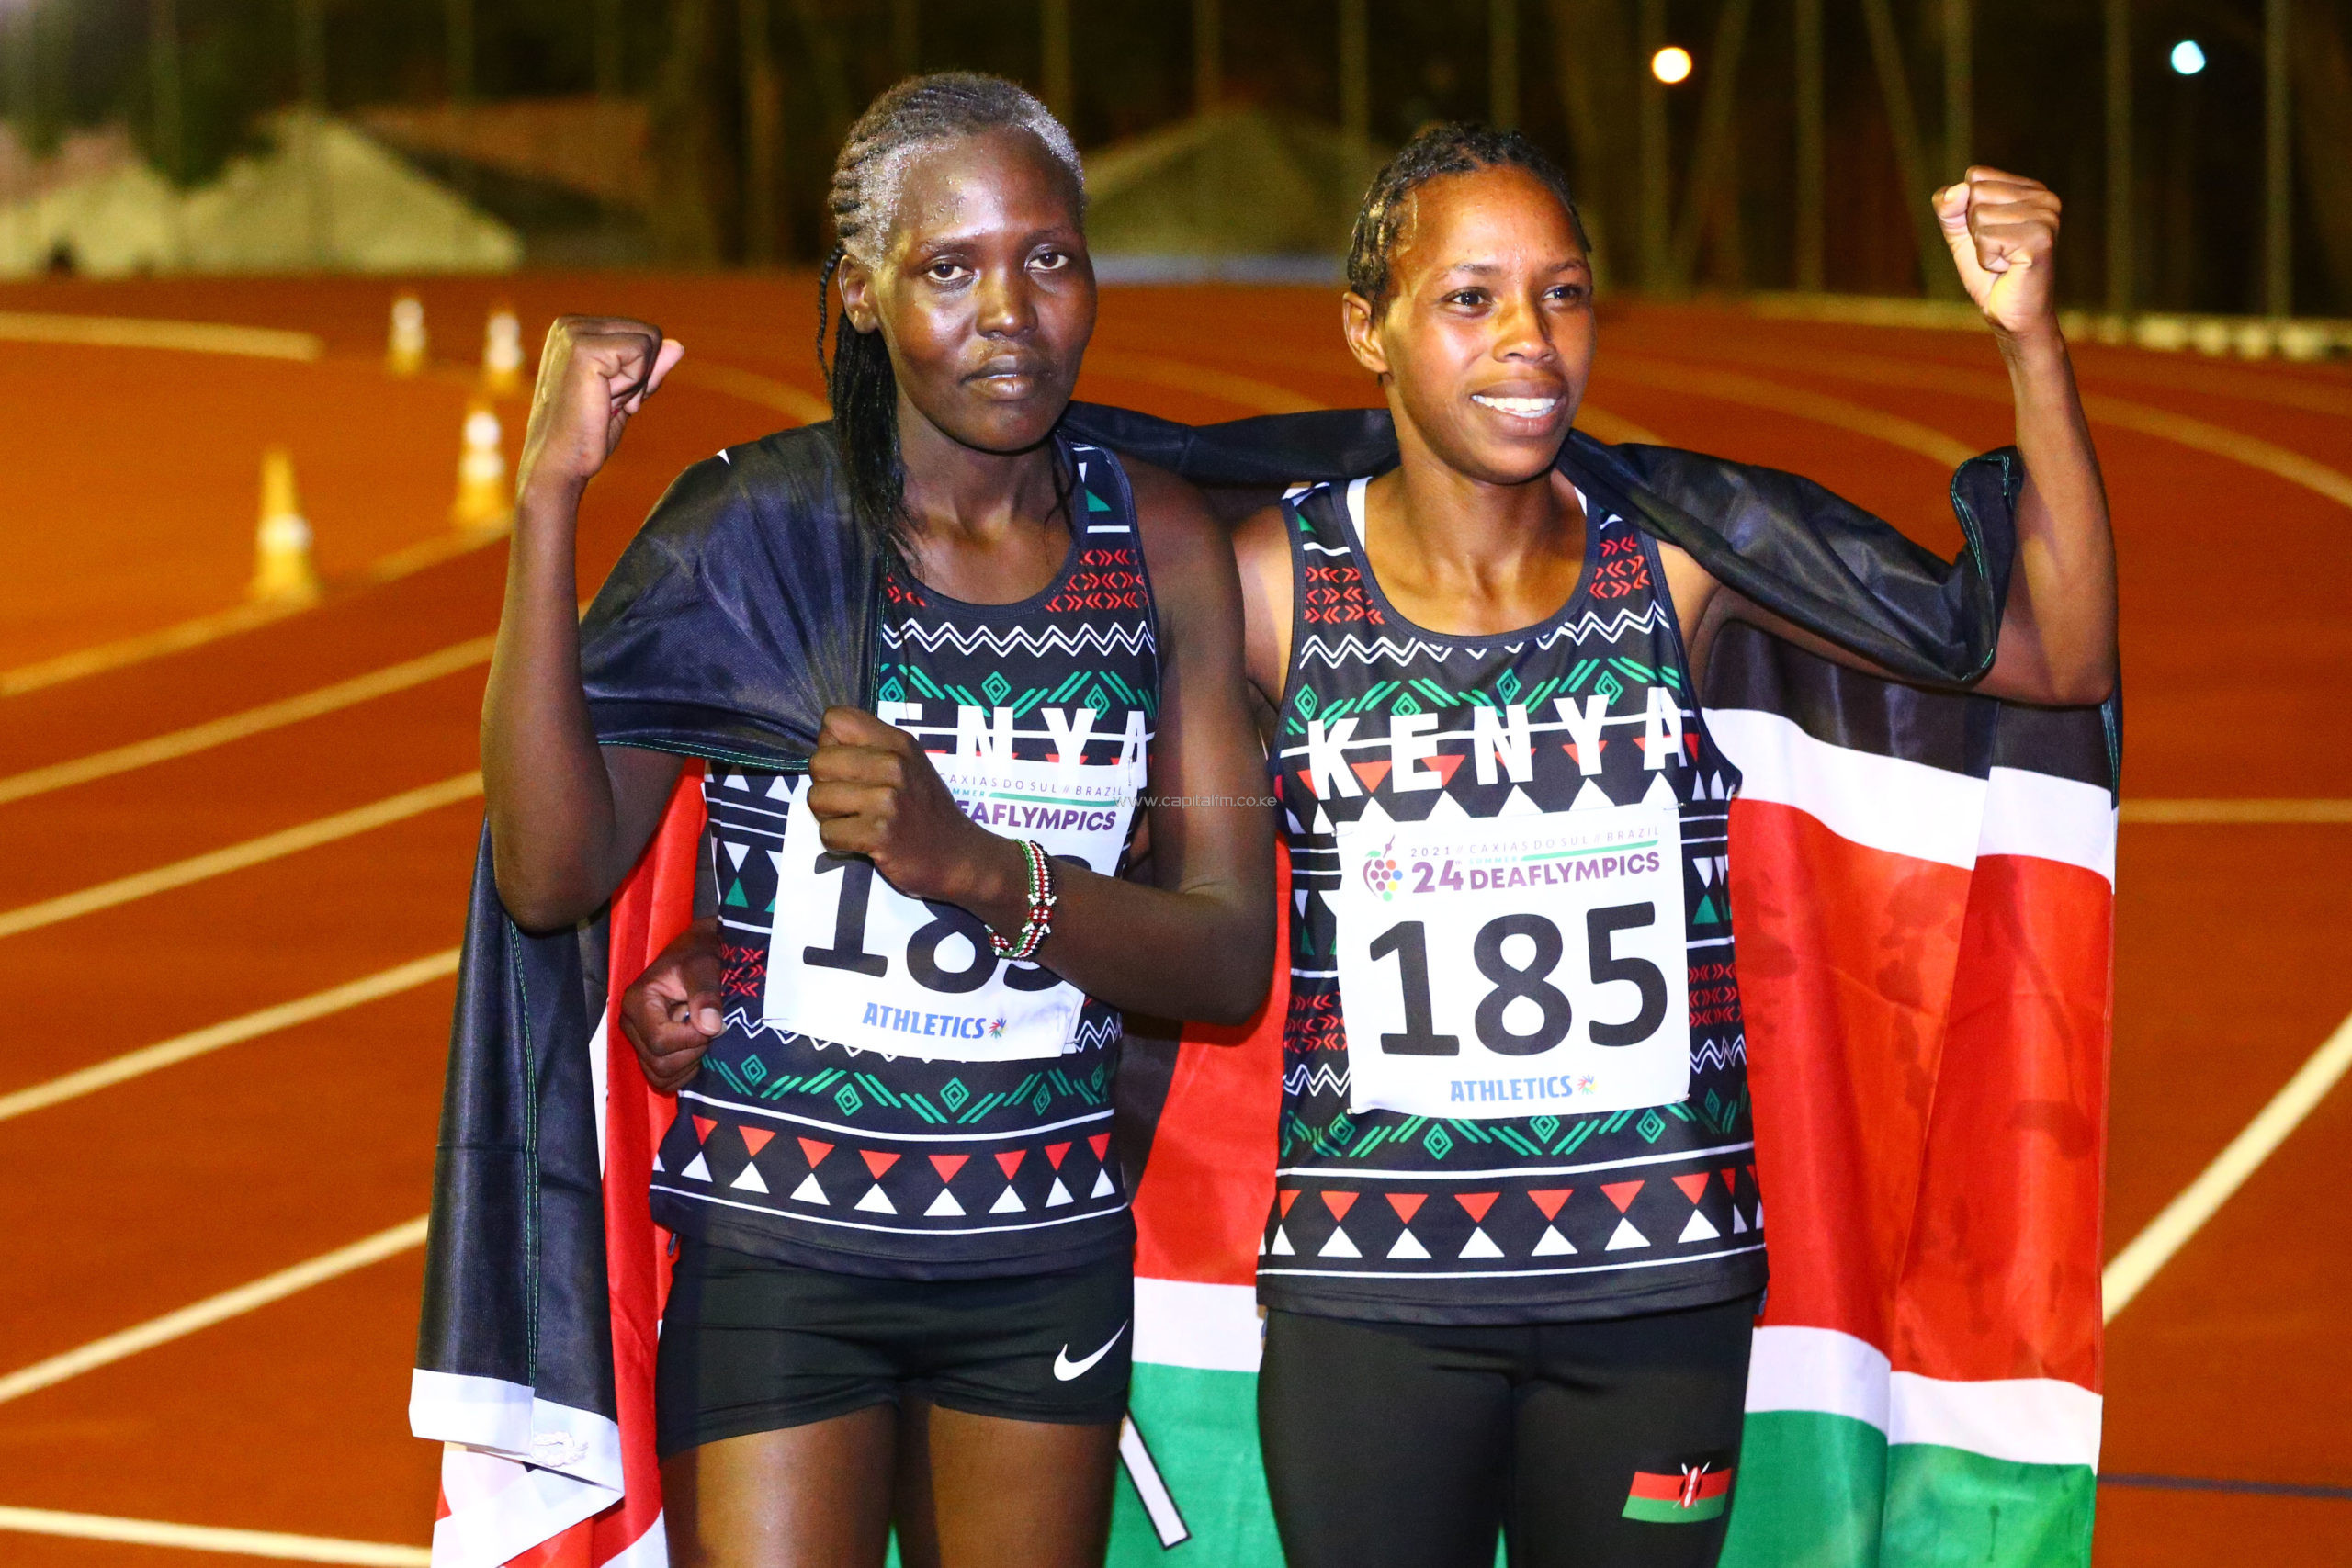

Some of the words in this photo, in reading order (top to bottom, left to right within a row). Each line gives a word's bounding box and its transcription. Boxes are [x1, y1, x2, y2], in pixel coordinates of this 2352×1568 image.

[1307, 686, 1688, 800] KENYA
[952, 787, 986, 797] MMER
[1003, 778, 1024, 790] DO
[1030, 781, 1057, 794] SUL
[1075, 785, 1124, 796] BRAZIL
[1410, 846, 1451, 858] 2021
[1469, 840, 1528, 854] CAXIAS
[1533, 839, 1555, 850] DO
[1560, 835, 1589, 847] SUL
[1606, 826, 1659, 842] BRAZIL
[1469, 851, 1660, 891] DEAFLYMPICS
[803, 851, 1093, 994] 18
[1369, 901, 1668, 1056] 185
[862, 1002, 987, 1040] ATHLETICS
[1450, 1075, 1573, 1102] ATHLETICS
